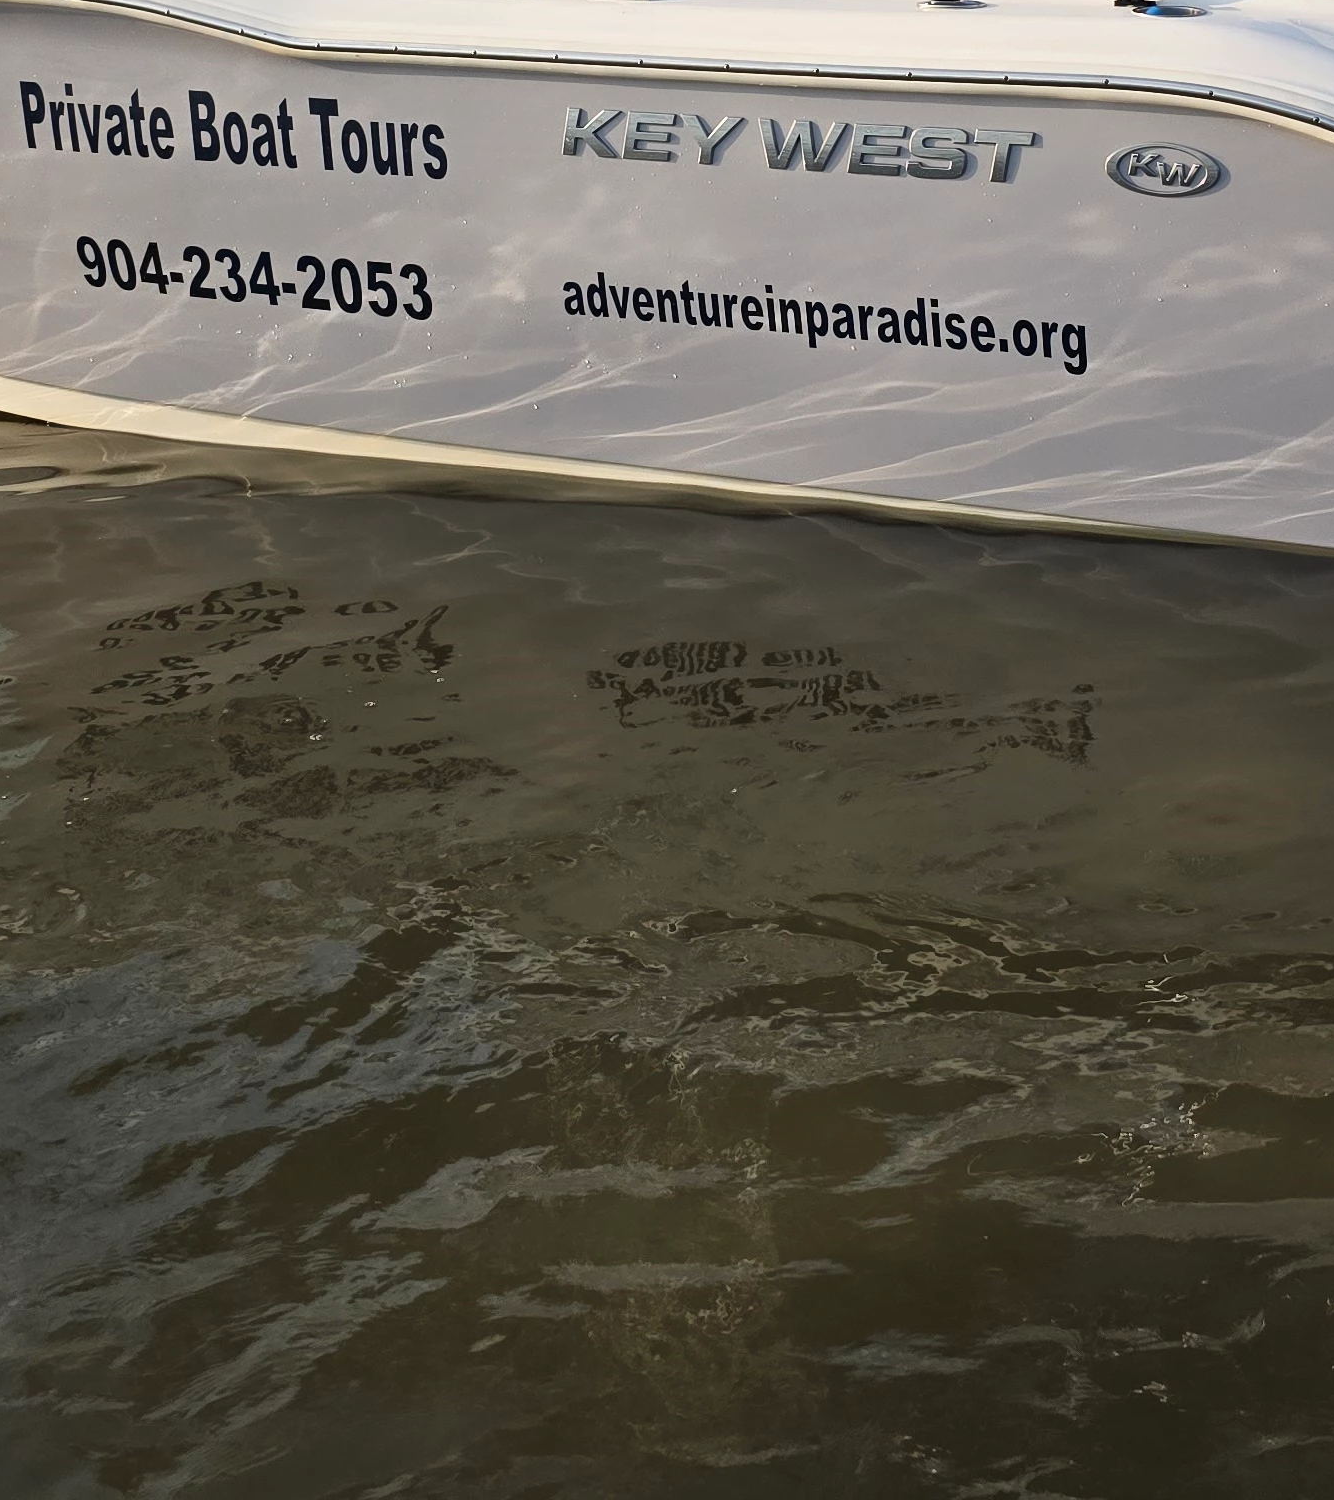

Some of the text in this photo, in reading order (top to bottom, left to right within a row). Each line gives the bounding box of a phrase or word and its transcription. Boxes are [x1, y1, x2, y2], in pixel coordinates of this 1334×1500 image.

[19, 80, 448, 180] Private Boat Tours
[562, 106, 1038, 183] KEY WEST
[1127, 152, 1203, 187] KW
[76, 235, 433, 321] 904-234-2053
[562, 271, 1088, 376] adventureinparadise.org
